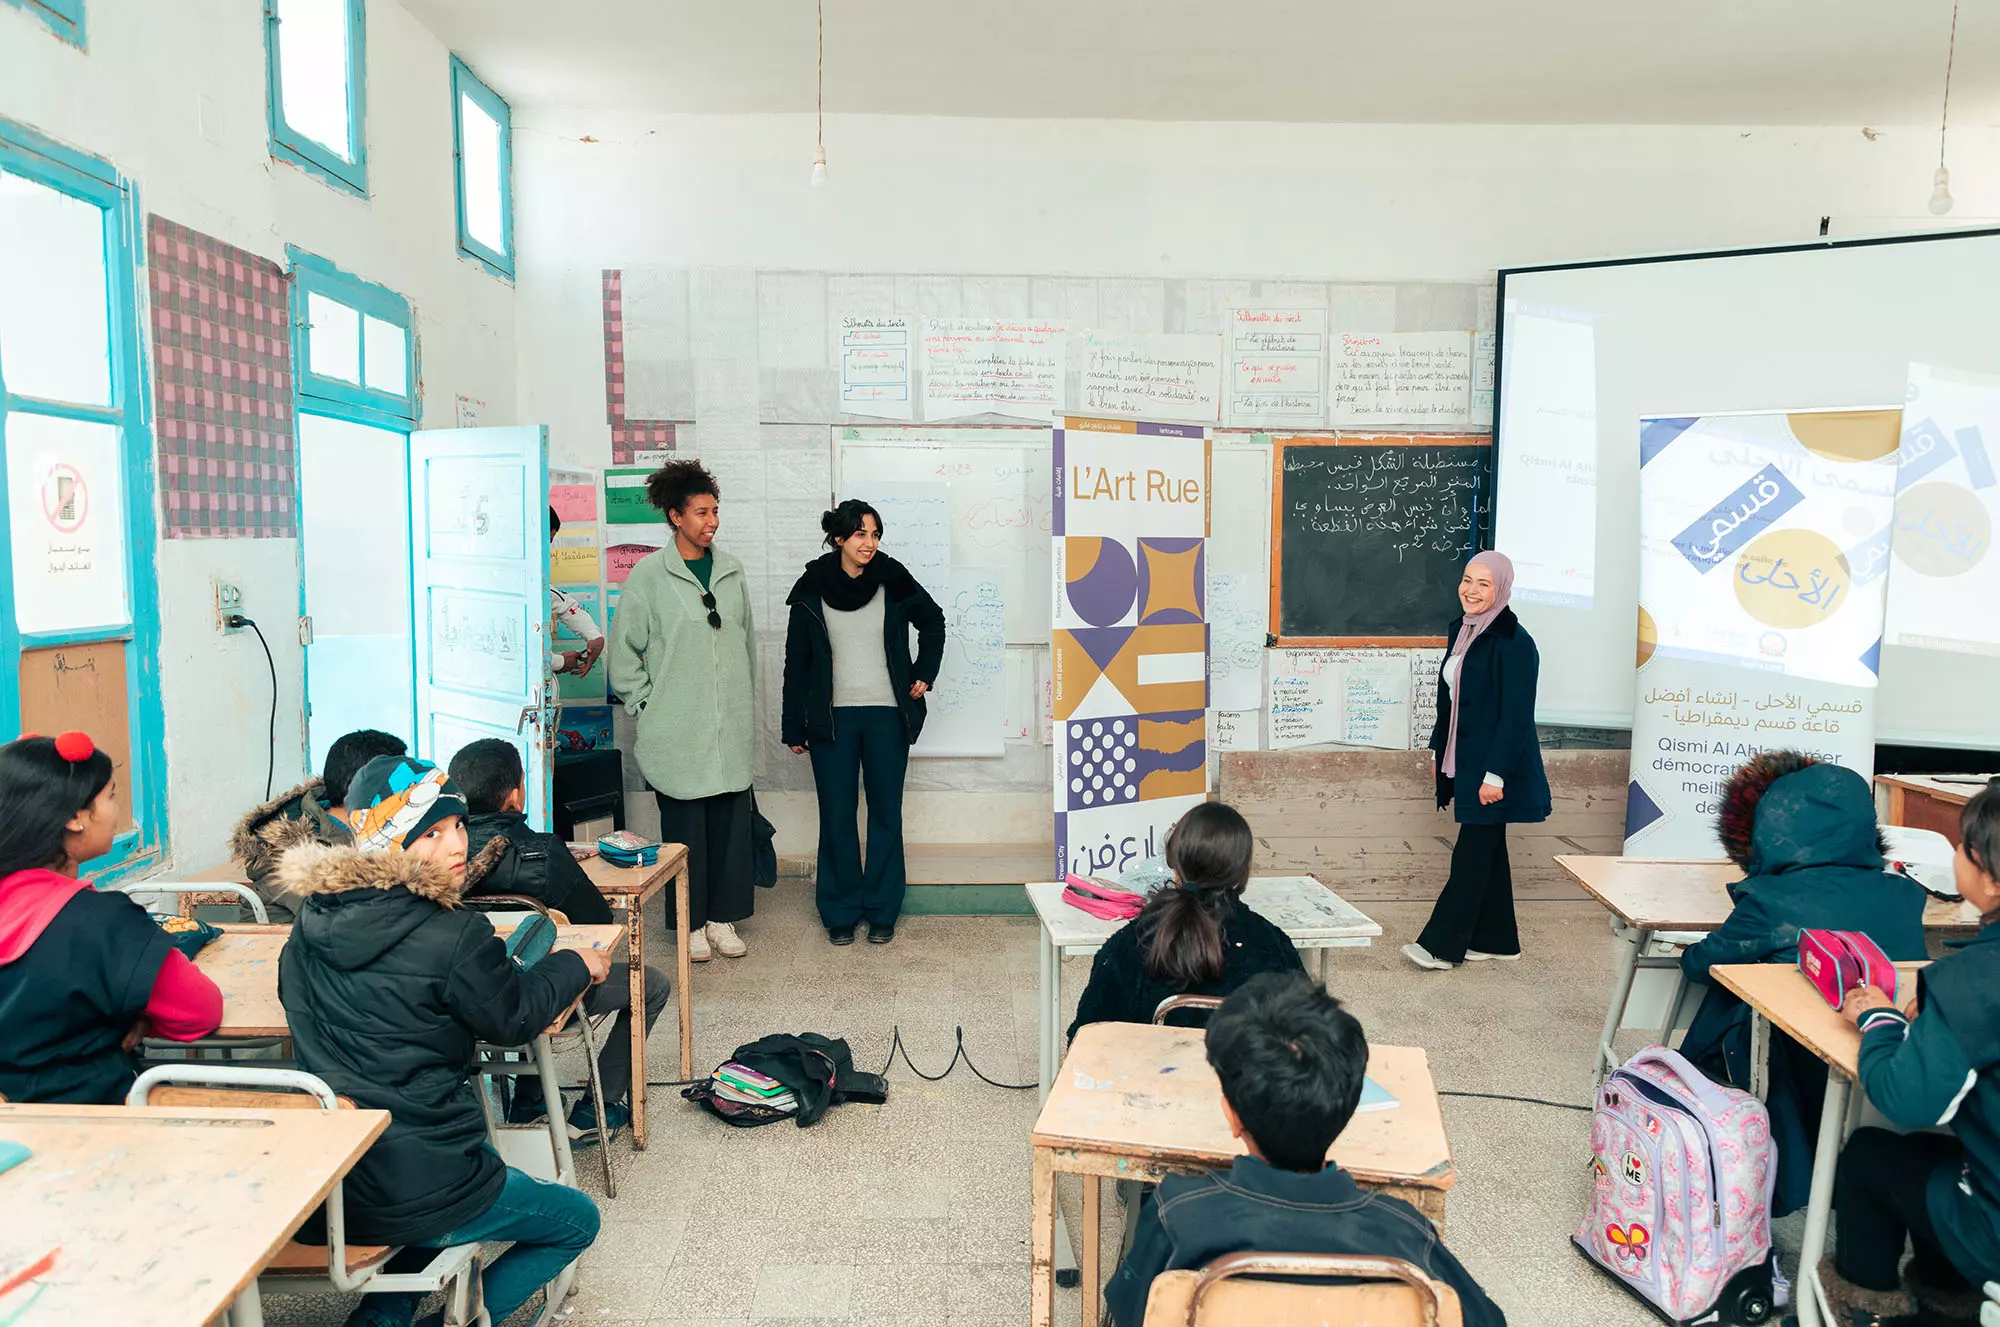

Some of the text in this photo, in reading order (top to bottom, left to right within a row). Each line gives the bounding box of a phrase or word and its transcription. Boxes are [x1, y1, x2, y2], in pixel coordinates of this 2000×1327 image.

[1086, 369, 1122, 381] raconter
[1125, 374, 1138, 382] un
[1519, 452, 1555, 469] Qismi
[1559, 457, 1573, 471] Al
[1074, 466, 1136, 501] L'Art
[1147, 469, 1199, 503] Rue
[1692, 473, 1781, 562] قسمي
[1741, 558, 1841, 611] الأحلى
[1645, 687, 1862, 719] قسمي الأحلى إنشاء أفضل
[1675, 704, 1840, 734] قاعة قسم ديمقراطياً
[1658, 737, 1708, 755] Qismi
[1713, 741, 1729, 755] Al
[1058, 845, 1066, 858] City
[1626, 1168, 1642, 1183] ME
